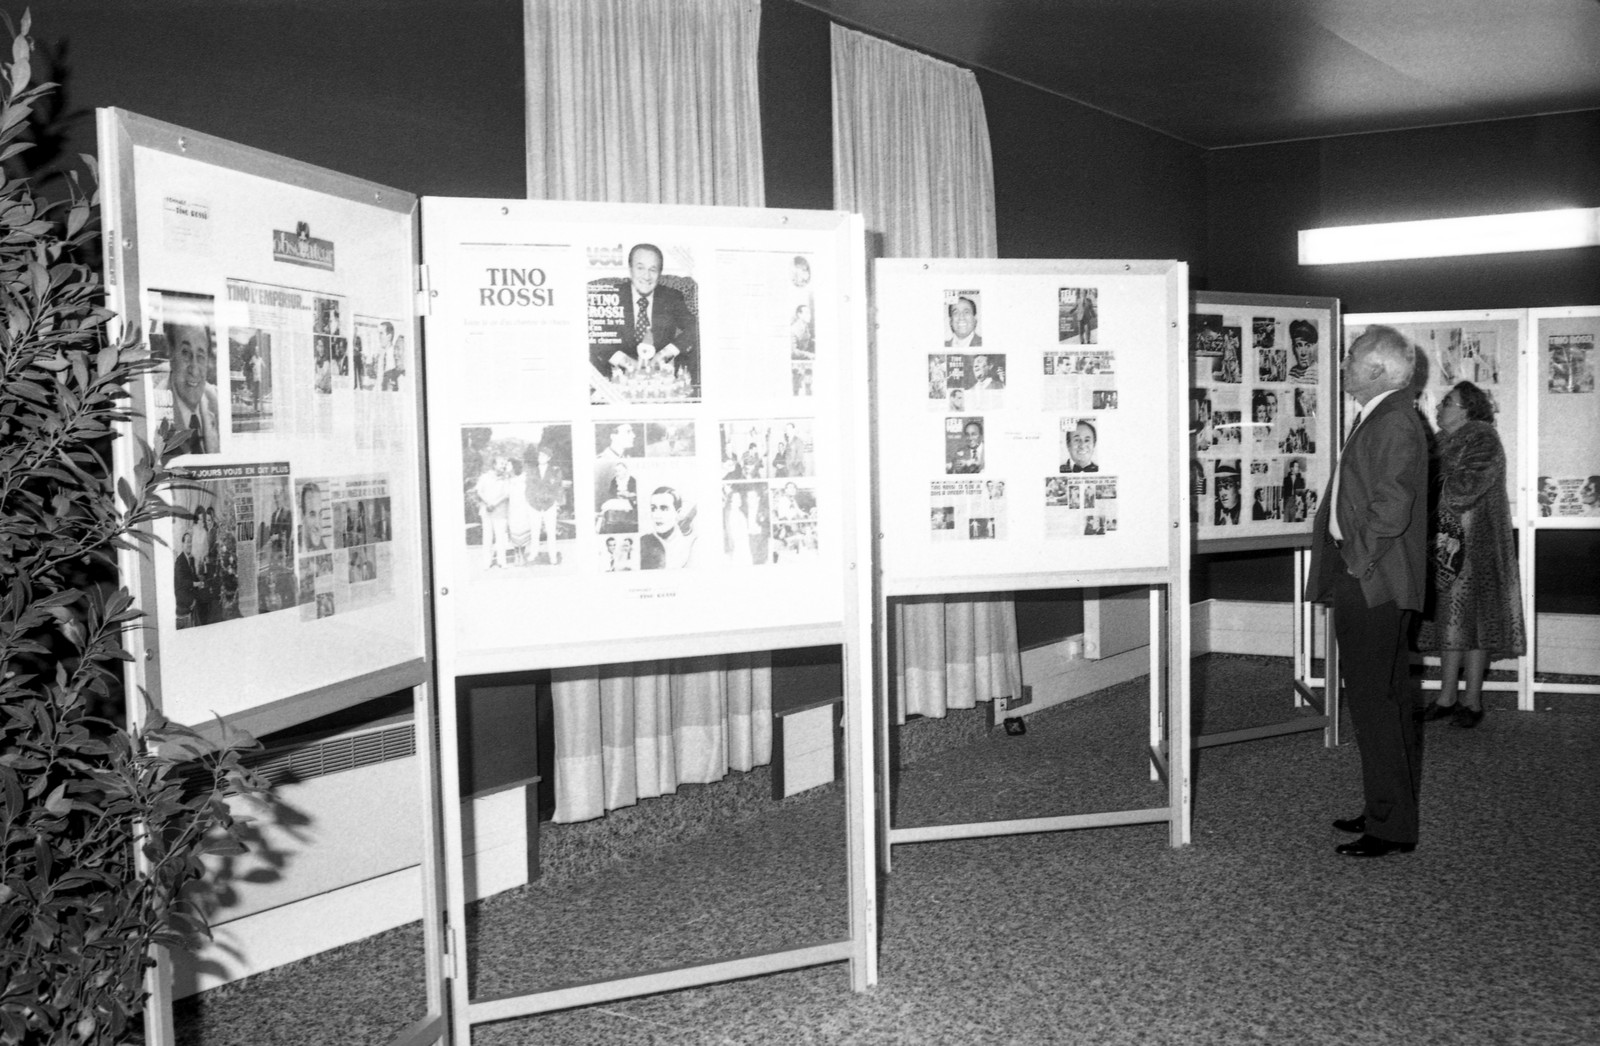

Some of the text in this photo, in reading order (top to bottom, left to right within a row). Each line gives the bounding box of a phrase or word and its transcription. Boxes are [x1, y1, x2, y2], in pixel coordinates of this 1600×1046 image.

[485, 267, 546, 287] TINO
[227, 284, 250, 303] TINO
[479, 287, 554, 307] ROSSI
[588, 294, 620, 306] TINO
[588, 306, 625, 318] ROSSI
[197, 469, 221, 477] JOURS
[223, 468, 243, 476] VOUS
[271, 466, 289, 474] PLUS
